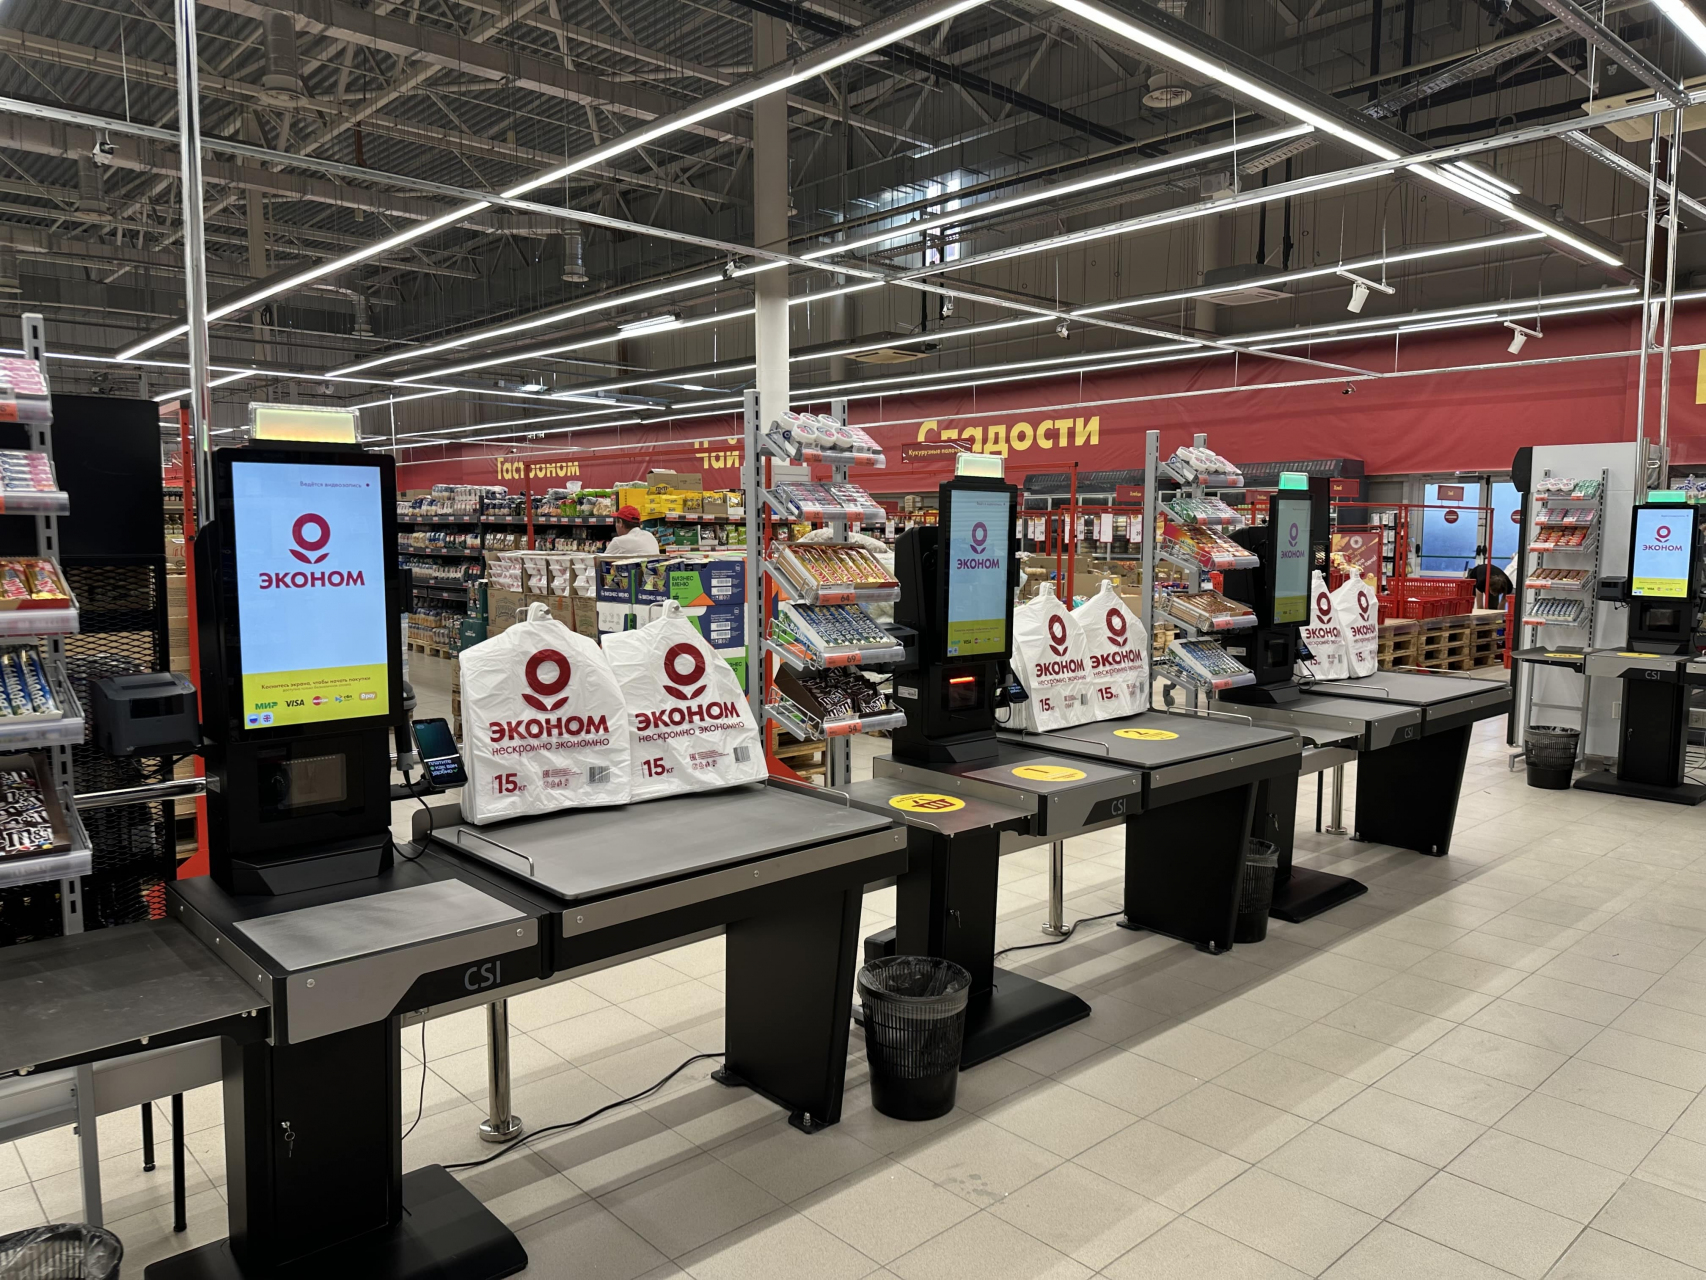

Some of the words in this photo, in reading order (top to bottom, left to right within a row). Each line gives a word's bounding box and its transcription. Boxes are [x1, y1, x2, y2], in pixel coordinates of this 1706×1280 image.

[908, 449, 940, 457] Кукурузные
[300, 480, 323, 488] Ведётся
[1280, 549, 1305, 559] ЭКОНОМ
[1642, 544, 1683, 552] ЭКОНОМ
[956, 558, 1000, 570] ЭКОНОМ
[259, 570, 365, 589] ЭКОНОМ
[846, 655, 857, 663] 69
[1089, 649, 1142, 669] ЭКОНОМ
[1356, 651, 1363, 662] 15
[1035, 658, 1085, 678] ЭКОНОМ
[1093, 667, 1127, 678] нескромно
[1037, 677, 1066, 687] нескромно
[1067, 674, 1087, 682] экономно
[1645, 670, 1660, 680] CSI
[24, 663, 46, 706] BOUNTY
[1098, 686, 1114, 701] 15
[255, 701, 278, 710] МИР
[285, 699, 305, 707] VISA
[1039, 697, 1051, 712] 15
[635, 701, 740, 732] ЭКОНОМ
[489, 715, 609, 742] ЭКОНОМ
[638, 728, 695, 743] нескромно
[698, 721, 745, 734] экономно
[848, 725, 858, 733] 54
[1404, 726, 1413, 738] CSI
[492, 742, 552, 757] нескромно
[555, 738, 609, 749] экономно
[432, 768, 453, 777] удобно
[643, 757, 666, 777] 15
[494, 773, 518, 794] 15
[1111, 798, 1127, 815] CSI
[464, 960, 501, 990] CSI
